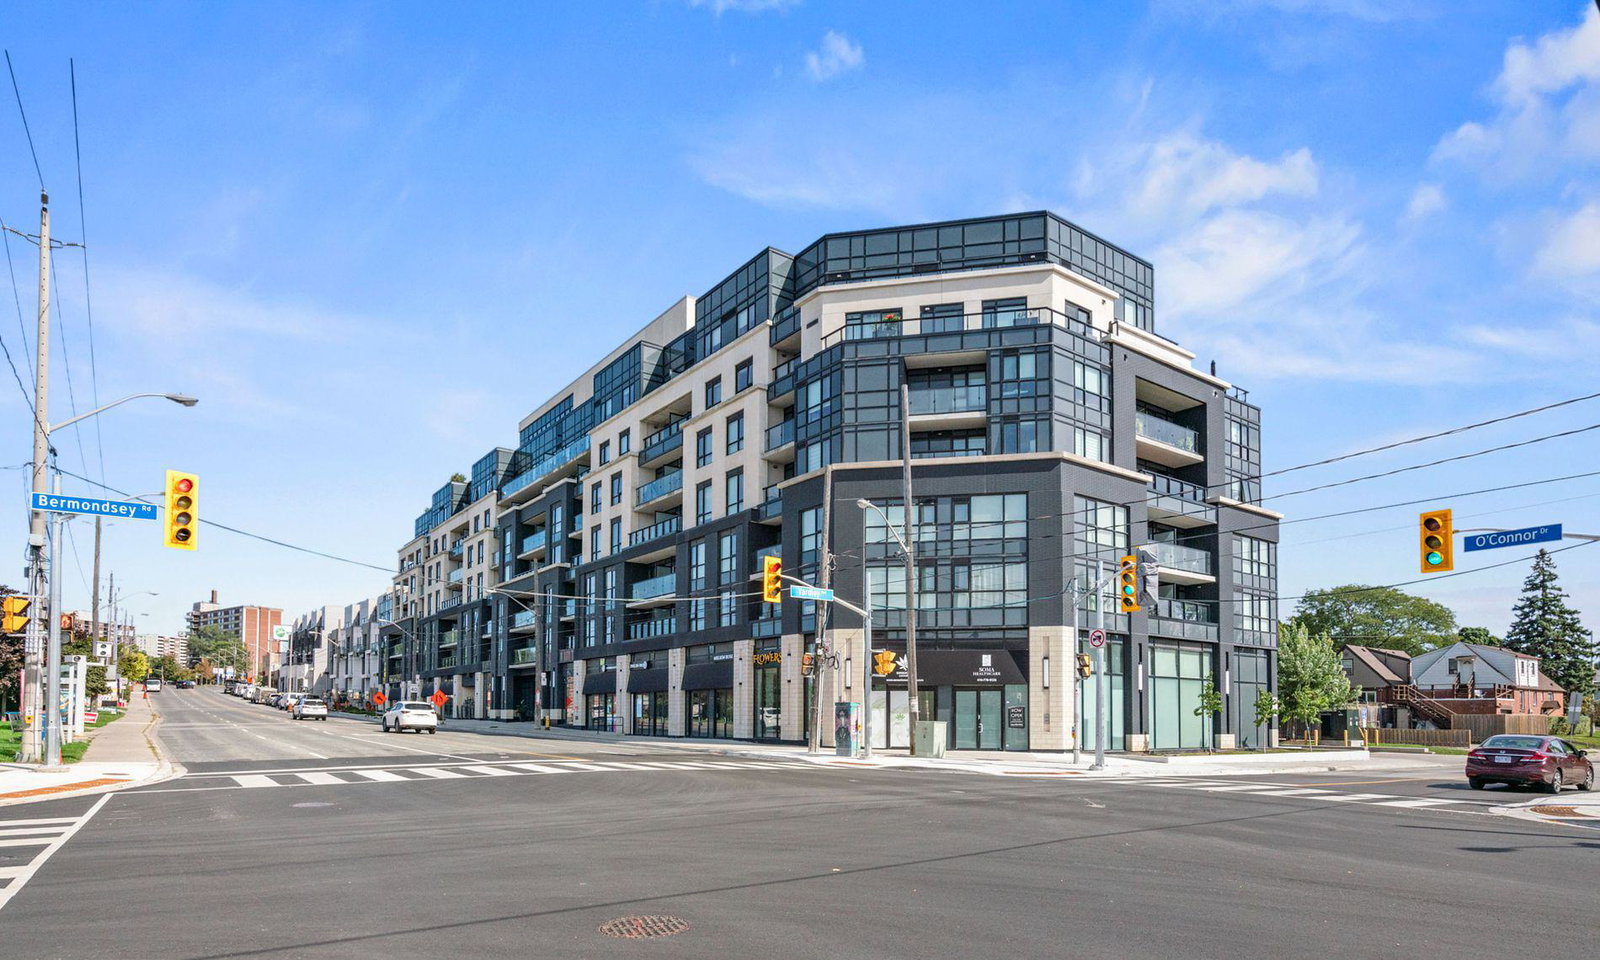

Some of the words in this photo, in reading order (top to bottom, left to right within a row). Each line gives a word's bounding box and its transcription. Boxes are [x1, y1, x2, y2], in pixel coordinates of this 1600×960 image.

[38, 495, 137, 518] Bermondsey
[1475, 530, 1538, 547] O'Connor
[752, 652, 782, 665] FLOWERS
